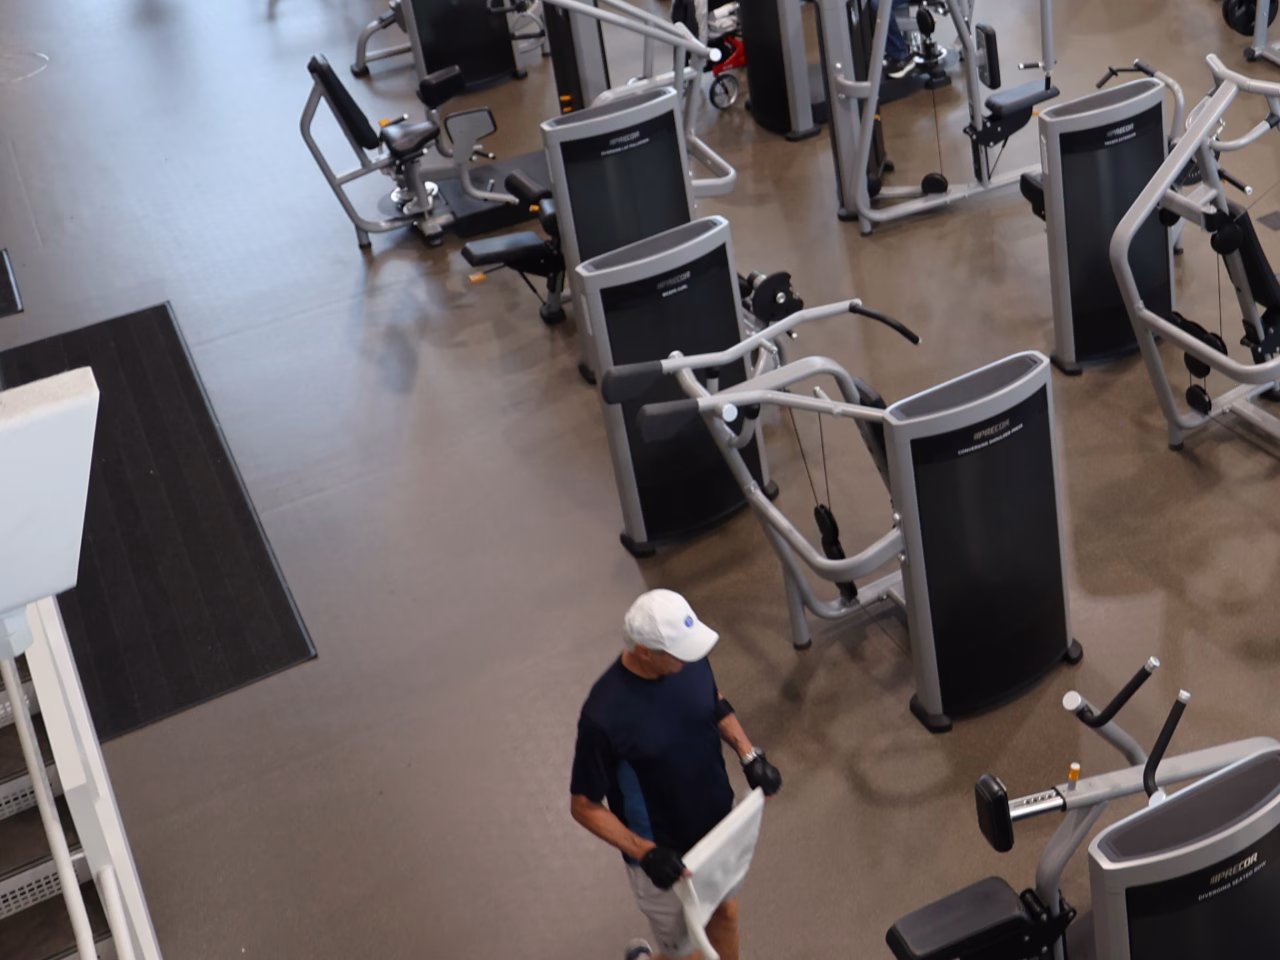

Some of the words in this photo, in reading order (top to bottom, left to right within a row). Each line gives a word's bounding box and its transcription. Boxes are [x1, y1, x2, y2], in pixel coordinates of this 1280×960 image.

[974, 419, 1010, 440] PRECOR
[1198, 883, 1231, 901] DIVERGING
[1232, 869, 1254, 886] SEATED
[1254, 860, 1267, 874] ROW
[1212, 851, 1258, 886] PRECOR
